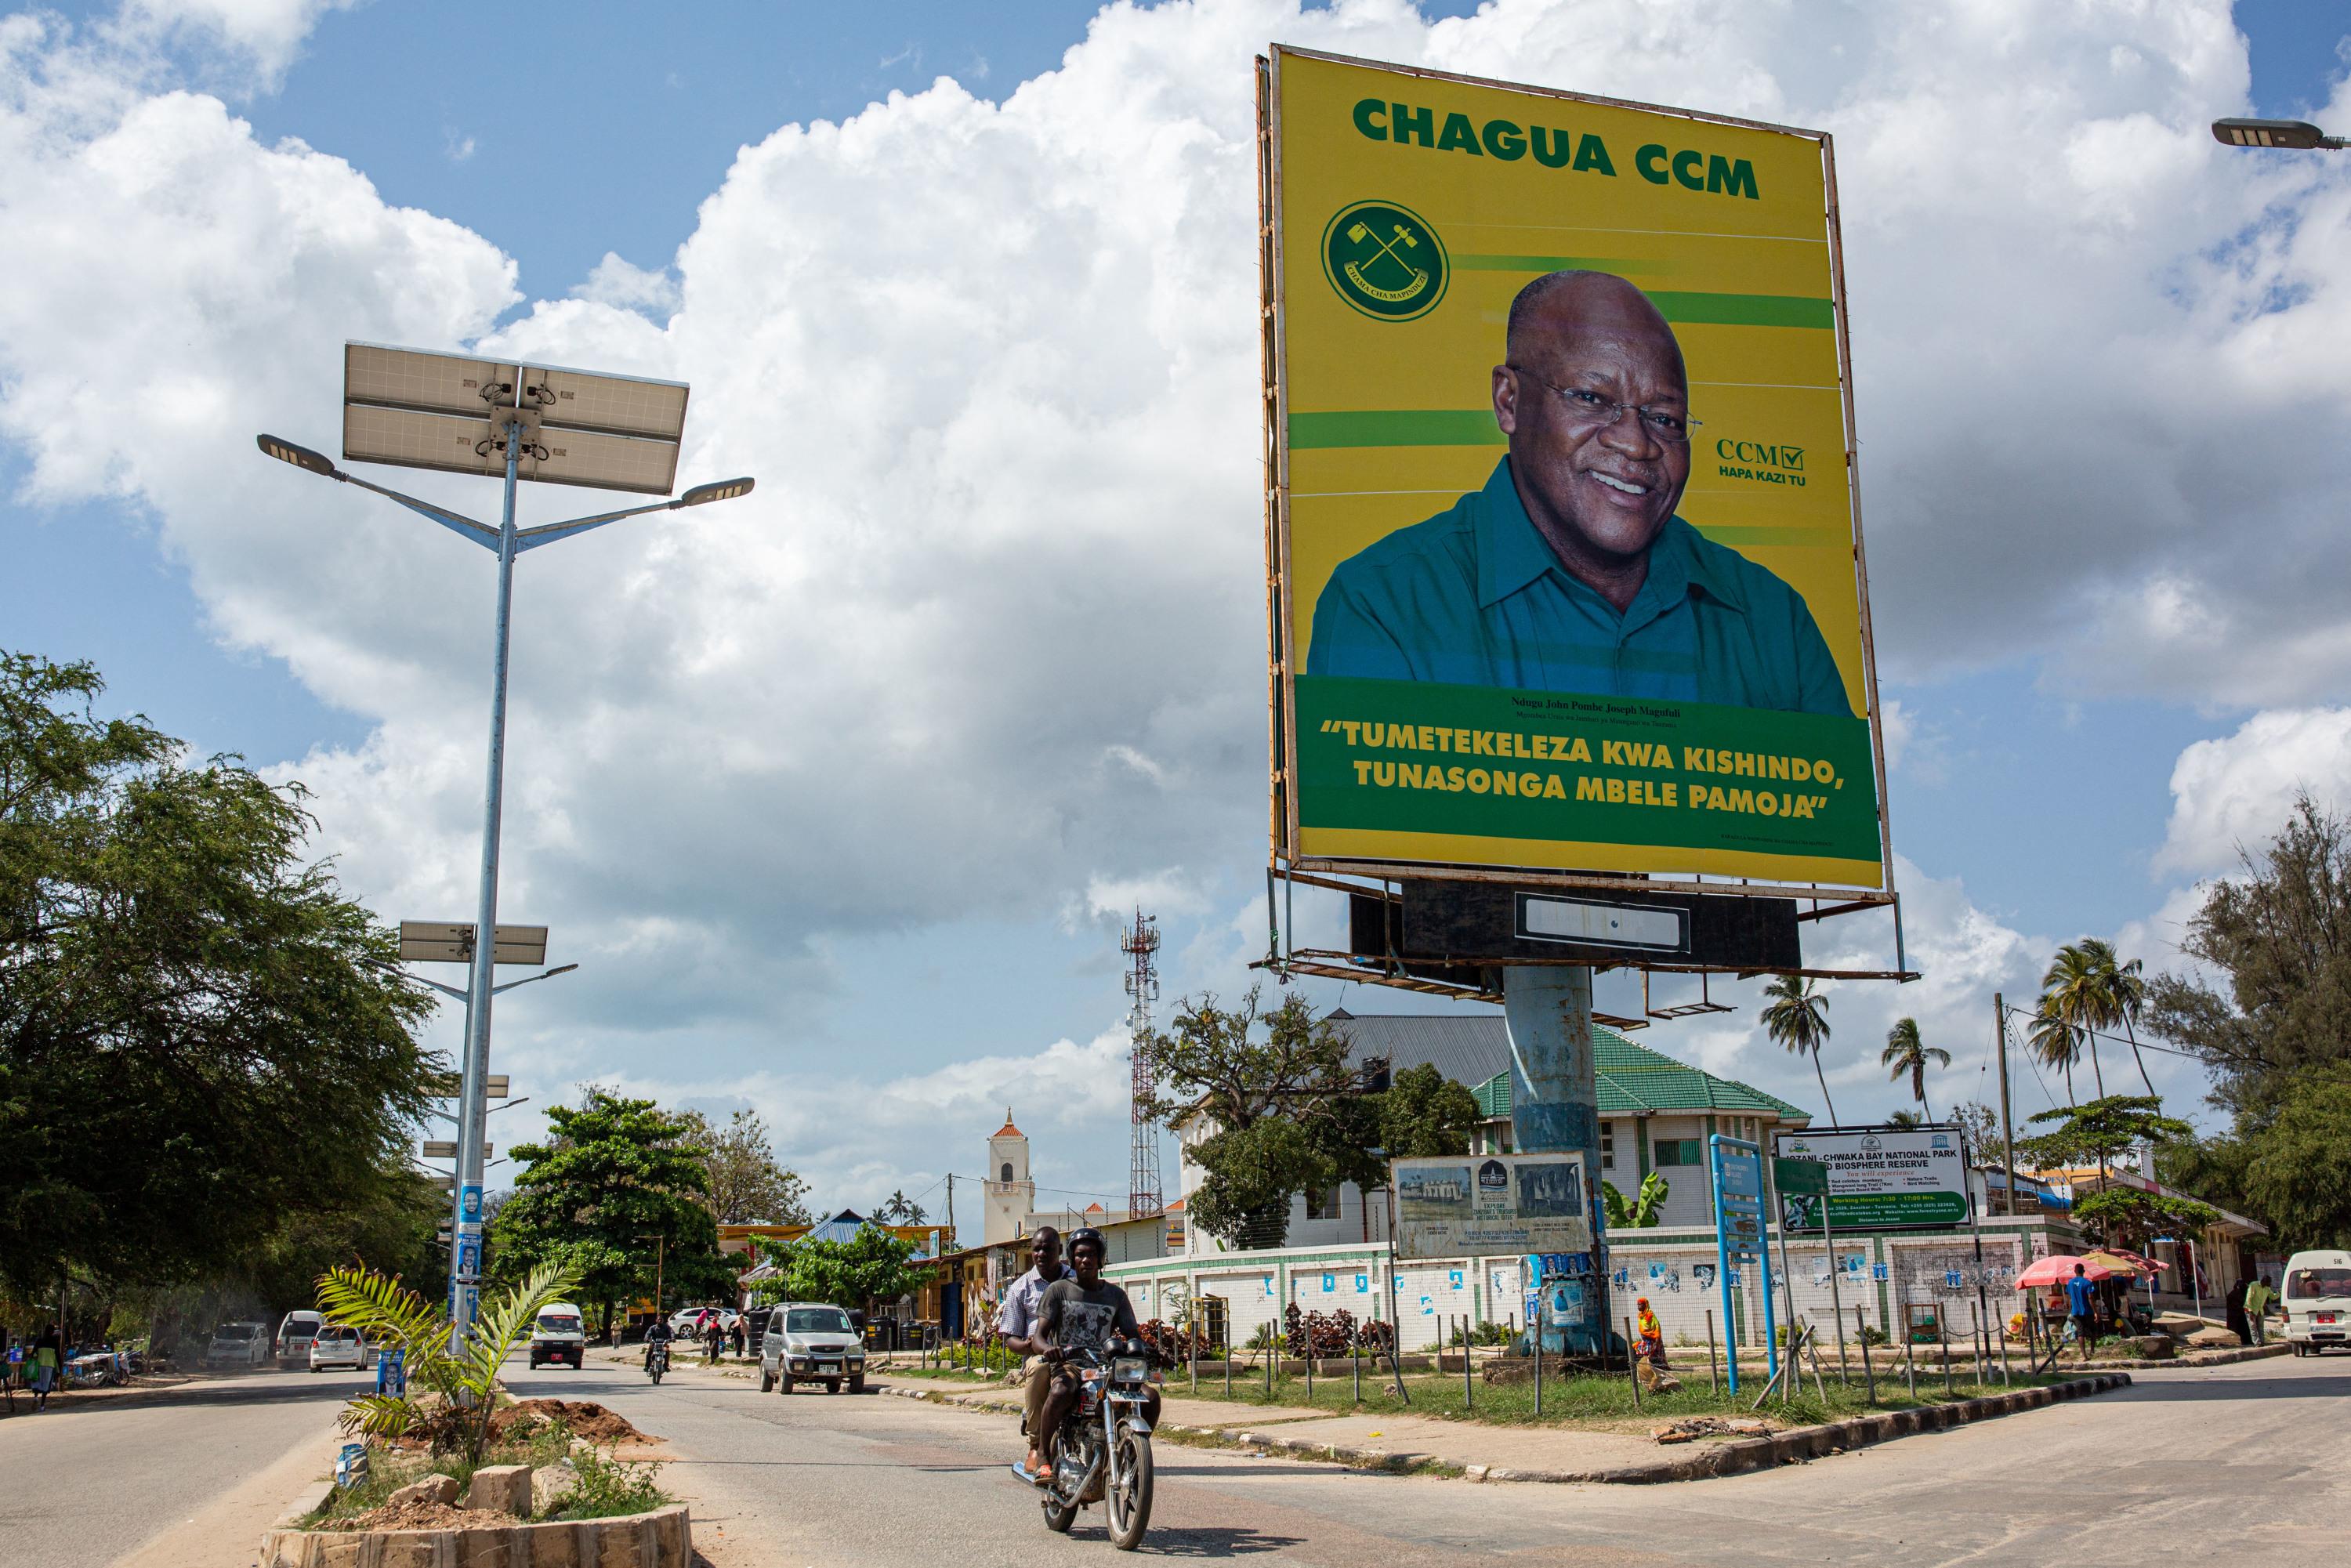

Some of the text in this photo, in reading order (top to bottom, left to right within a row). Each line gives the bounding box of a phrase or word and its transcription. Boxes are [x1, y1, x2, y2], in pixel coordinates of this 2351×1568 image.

[1353, 98, 1760, 200] CHAGUA CCM
[1348, 266, 1426, 299] CHAMA CHA MAPINDUZI
[1716, 439, 1779, 466] CCM
[1719, 465, 1806, 487] HAPA KAZI TU
[1511, 696, 1681, 719] Ndugu John Pombe Joseph Magufuli
[1320, 720, 1844, 790] “TUMETEKELEZA KWA KISHINDO,
[1353, 761, 1828, 819] TUNASONGA MBELE PAMOJA”
[1824, 1153, 1864, 1162] CHWAKA
[1866, 1152, 1883, 1161] BAY
[1886, 1150, 1931, 1159] NATIONAL
[1933, 1150, 1957, 1158] PARK
[1835, 1161, 1886, 1170] BIOSPHERE
[1887, 1160, 1929, 1169] RESERVE
[1877, 1170, 1914, 1179] experience
